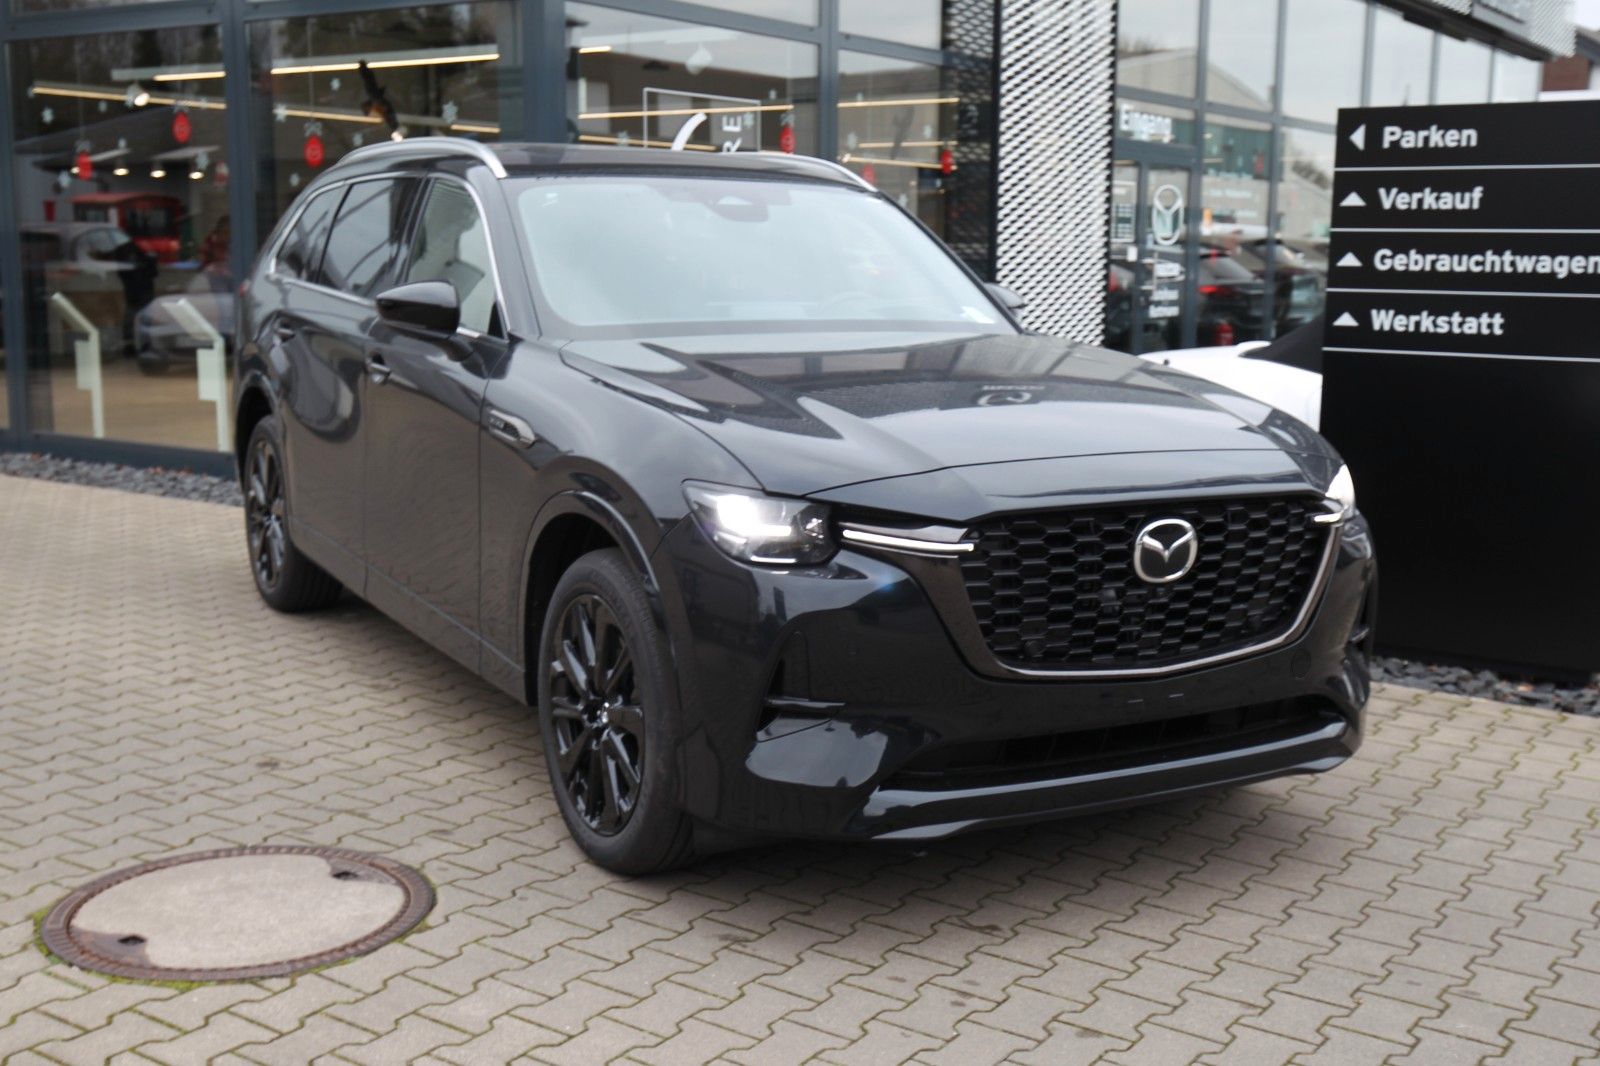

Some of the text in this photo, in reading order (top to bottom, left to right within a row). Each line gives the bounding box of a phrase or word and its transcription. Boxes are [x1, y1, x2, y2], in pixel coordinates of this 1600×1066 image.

[1382, 125, 1478, 149] Parken
[1378, 186, 1483, 211] Verkauf
[1373, 248, 1600, 279] Gebrauchtwagen
[1370, 308, 1505, 336] Werkstatt
